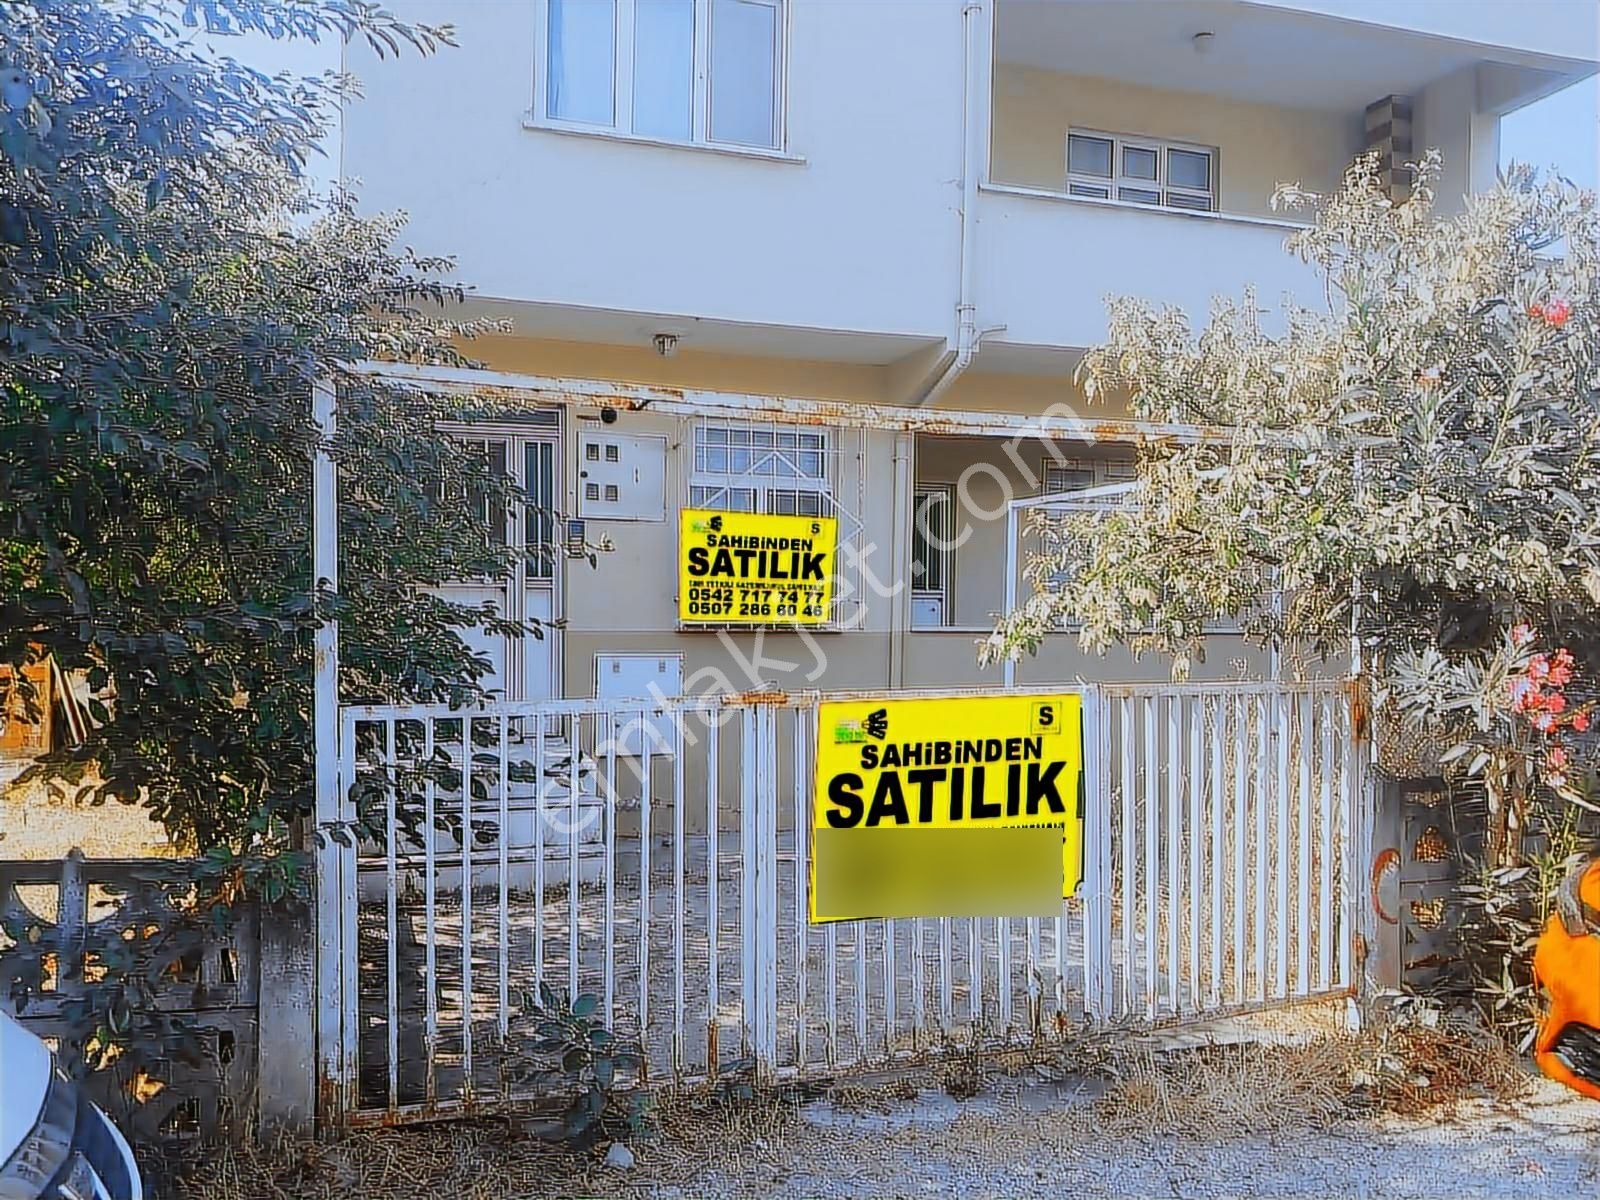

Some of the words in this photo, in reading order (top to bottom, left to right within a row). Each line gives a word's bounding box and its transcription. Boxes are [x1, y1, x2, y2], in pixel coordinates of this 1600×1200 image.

[811, 523, 821, 534] S
[688, 547, 826, 580] SATILIK
[688, 589, 733, 601] 0542
[740, 590, 772, 602] 717
[778, 591, 799, 603] 74
[804, 592, 824, 603] 77
[688, 602, 733, 614] 0507
[739, 603, 771, 615] 286
[802, 605, 823, 616] 46
[1039, 705, 1054, 726] S
[826, 761, 1068, 830] SATILIK
